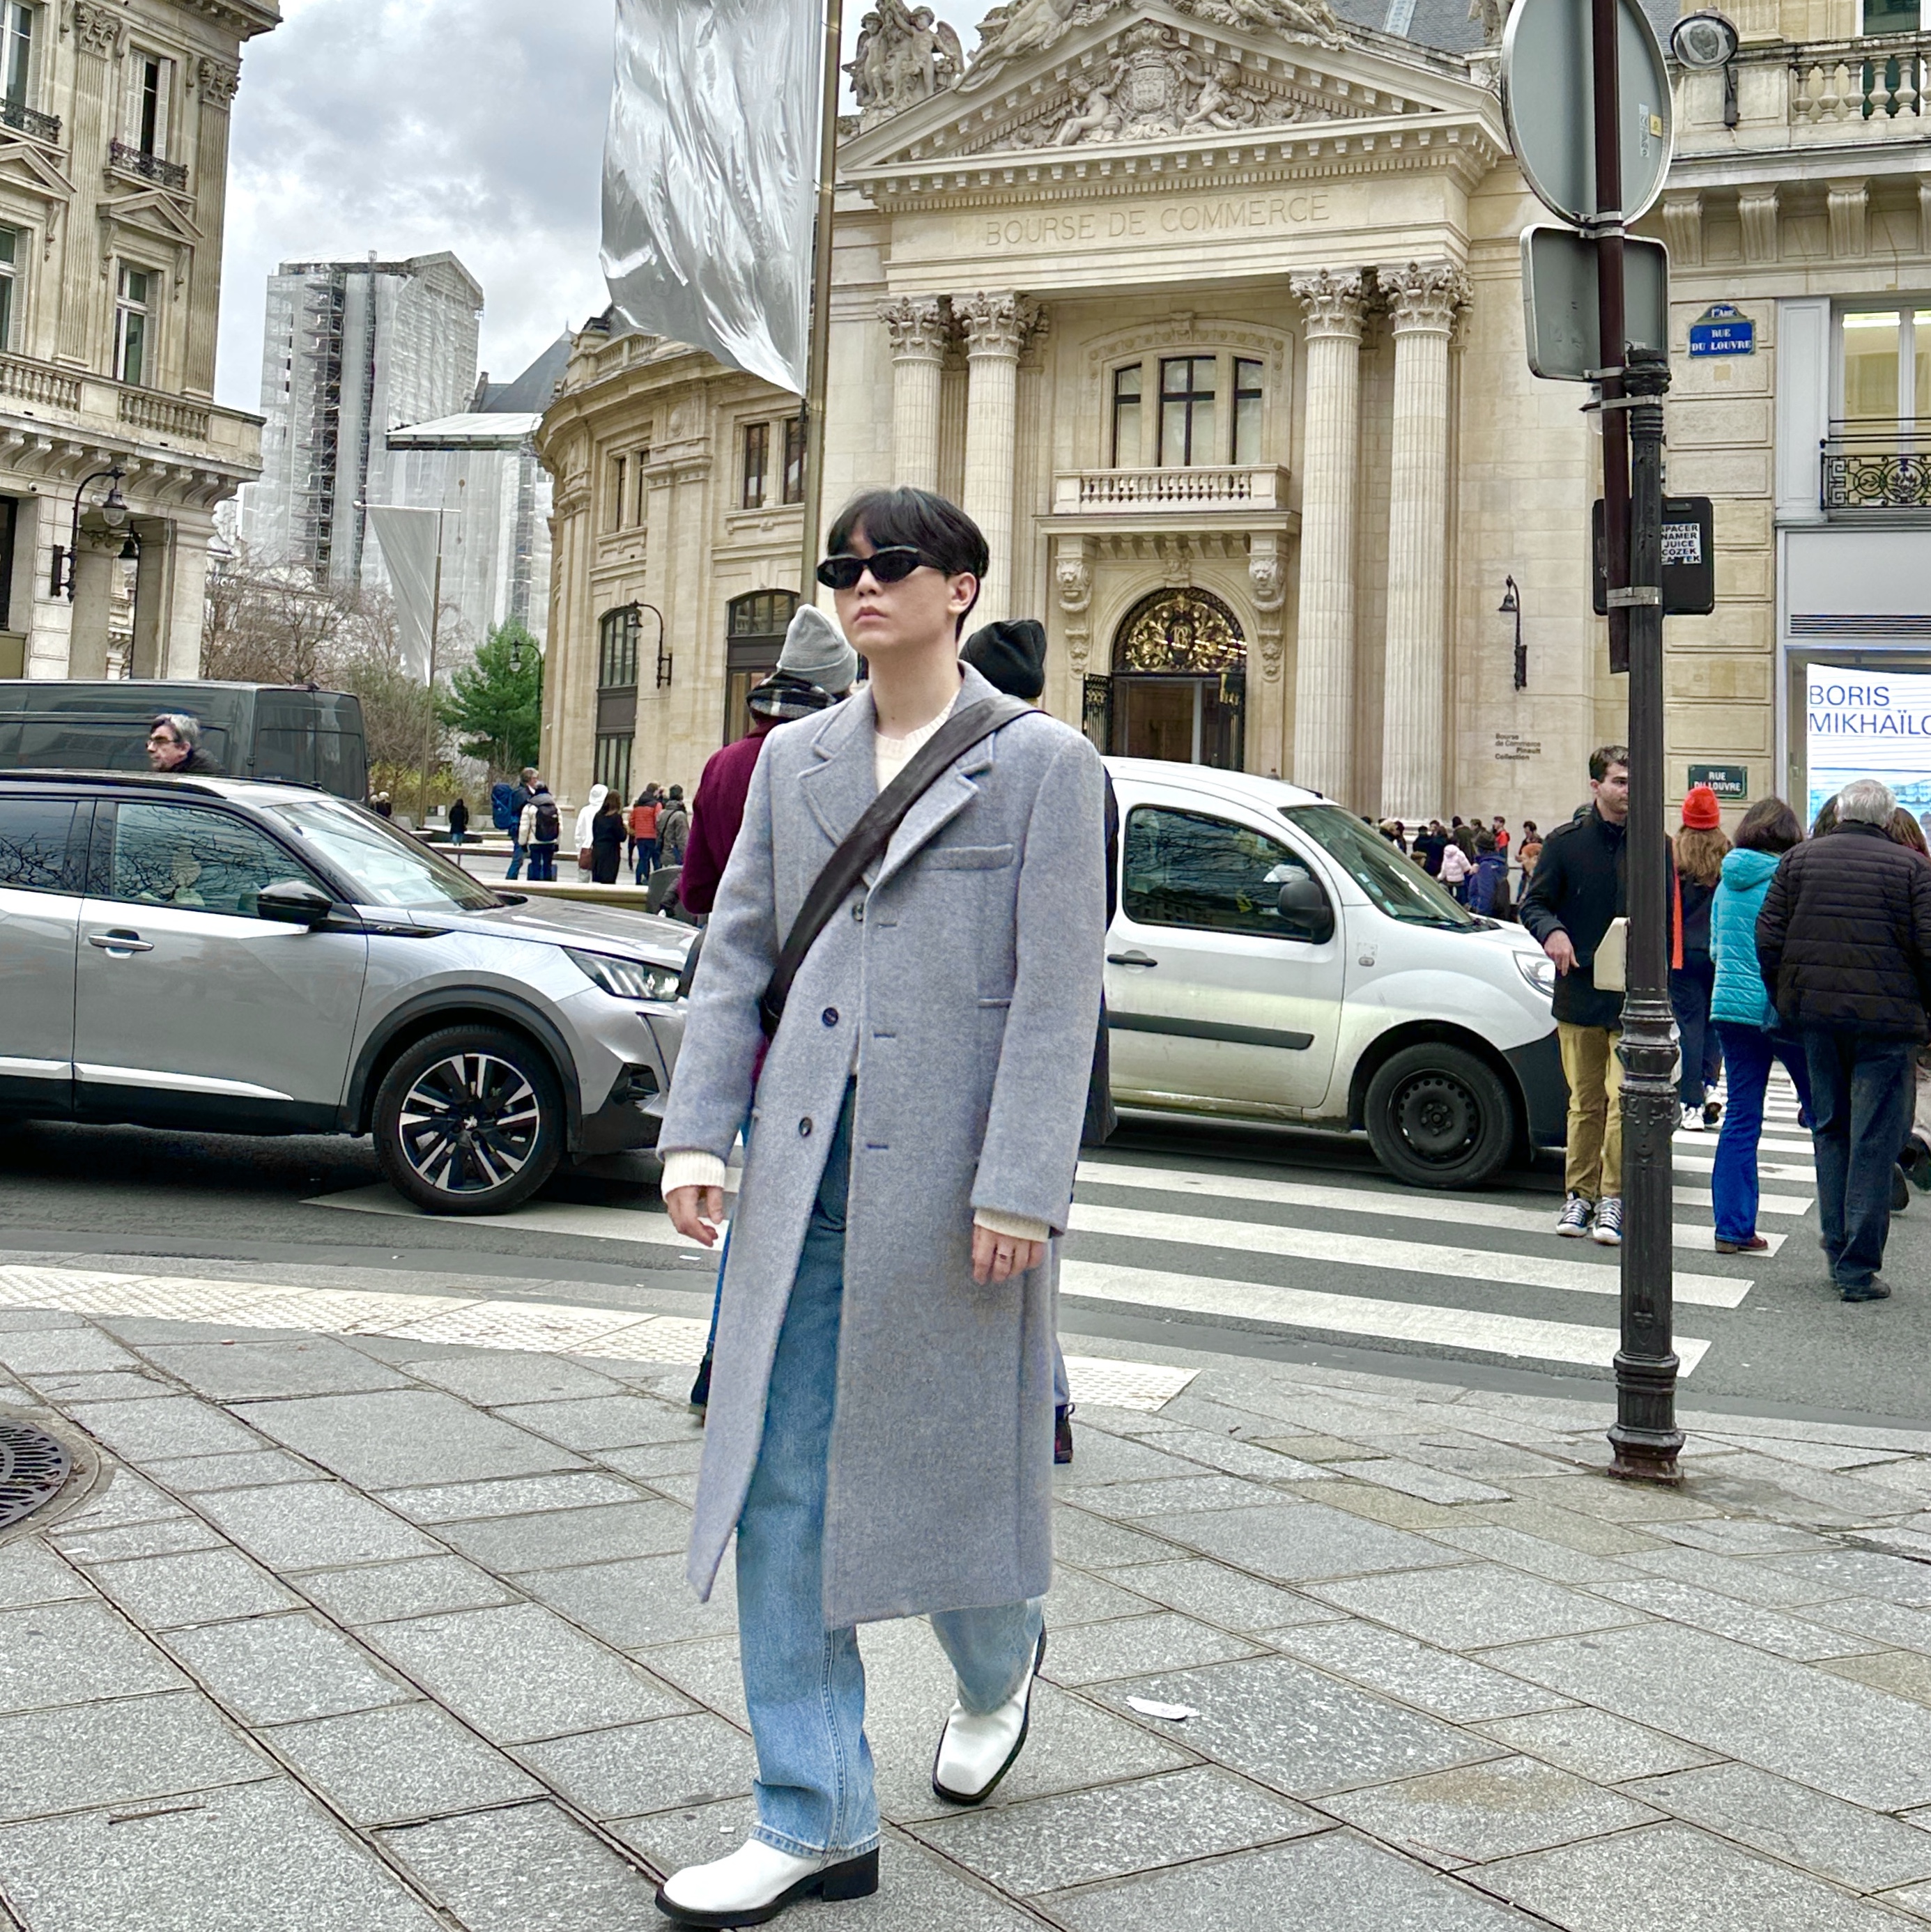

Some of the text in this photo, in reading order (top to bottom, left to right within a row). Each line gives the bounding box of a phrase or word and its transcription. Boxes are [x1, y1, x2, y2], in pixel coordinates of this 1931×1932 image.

[985, 194, 1330, 246] BOURSE DE COMMERCE
[1711, 328, 1732, 338] RUE
[1692, 340, 1752, 351] DU LOUVRE
[1810, 685, 1890, 706] BORIS
[1709, 771, 1726, 780] RUE
[1708, 781, 1741, 791] LOUVRE
